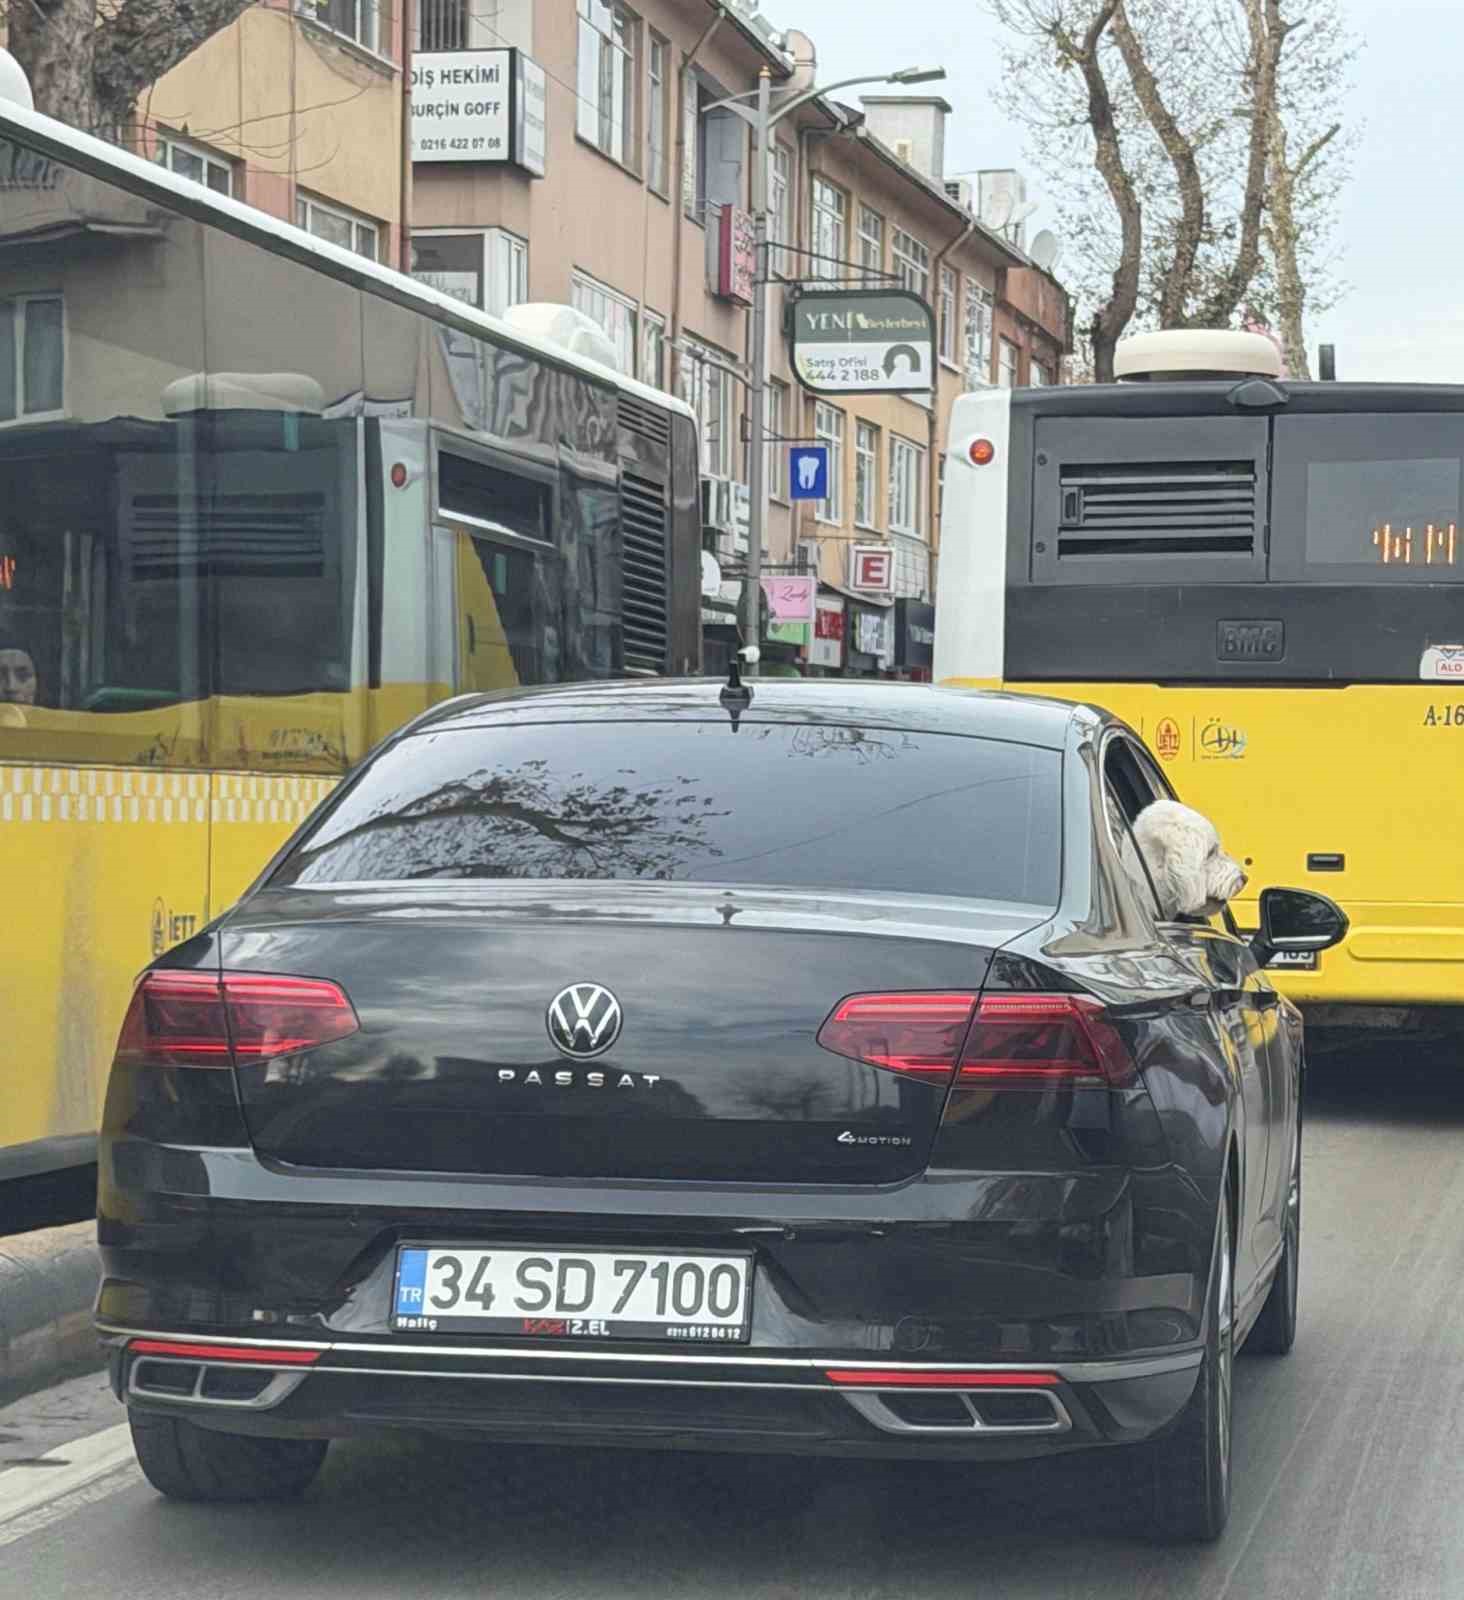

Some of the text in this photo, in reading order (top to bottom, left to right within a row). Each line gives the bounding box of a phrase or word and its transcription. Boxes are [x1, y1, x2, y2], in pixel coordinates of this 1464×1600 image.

[440, 64, 500, 85] HEKİMİ
[463, 101, 501, 116] GOFF
[840, 370, 850, 381] 2
[854, 369, 880, 381] 188
[861, 556, 885, 584] E
[497, 1069, 661, 1089] PASSAT
[399, 1255, 741, 1319] TR 34 SD 7100
